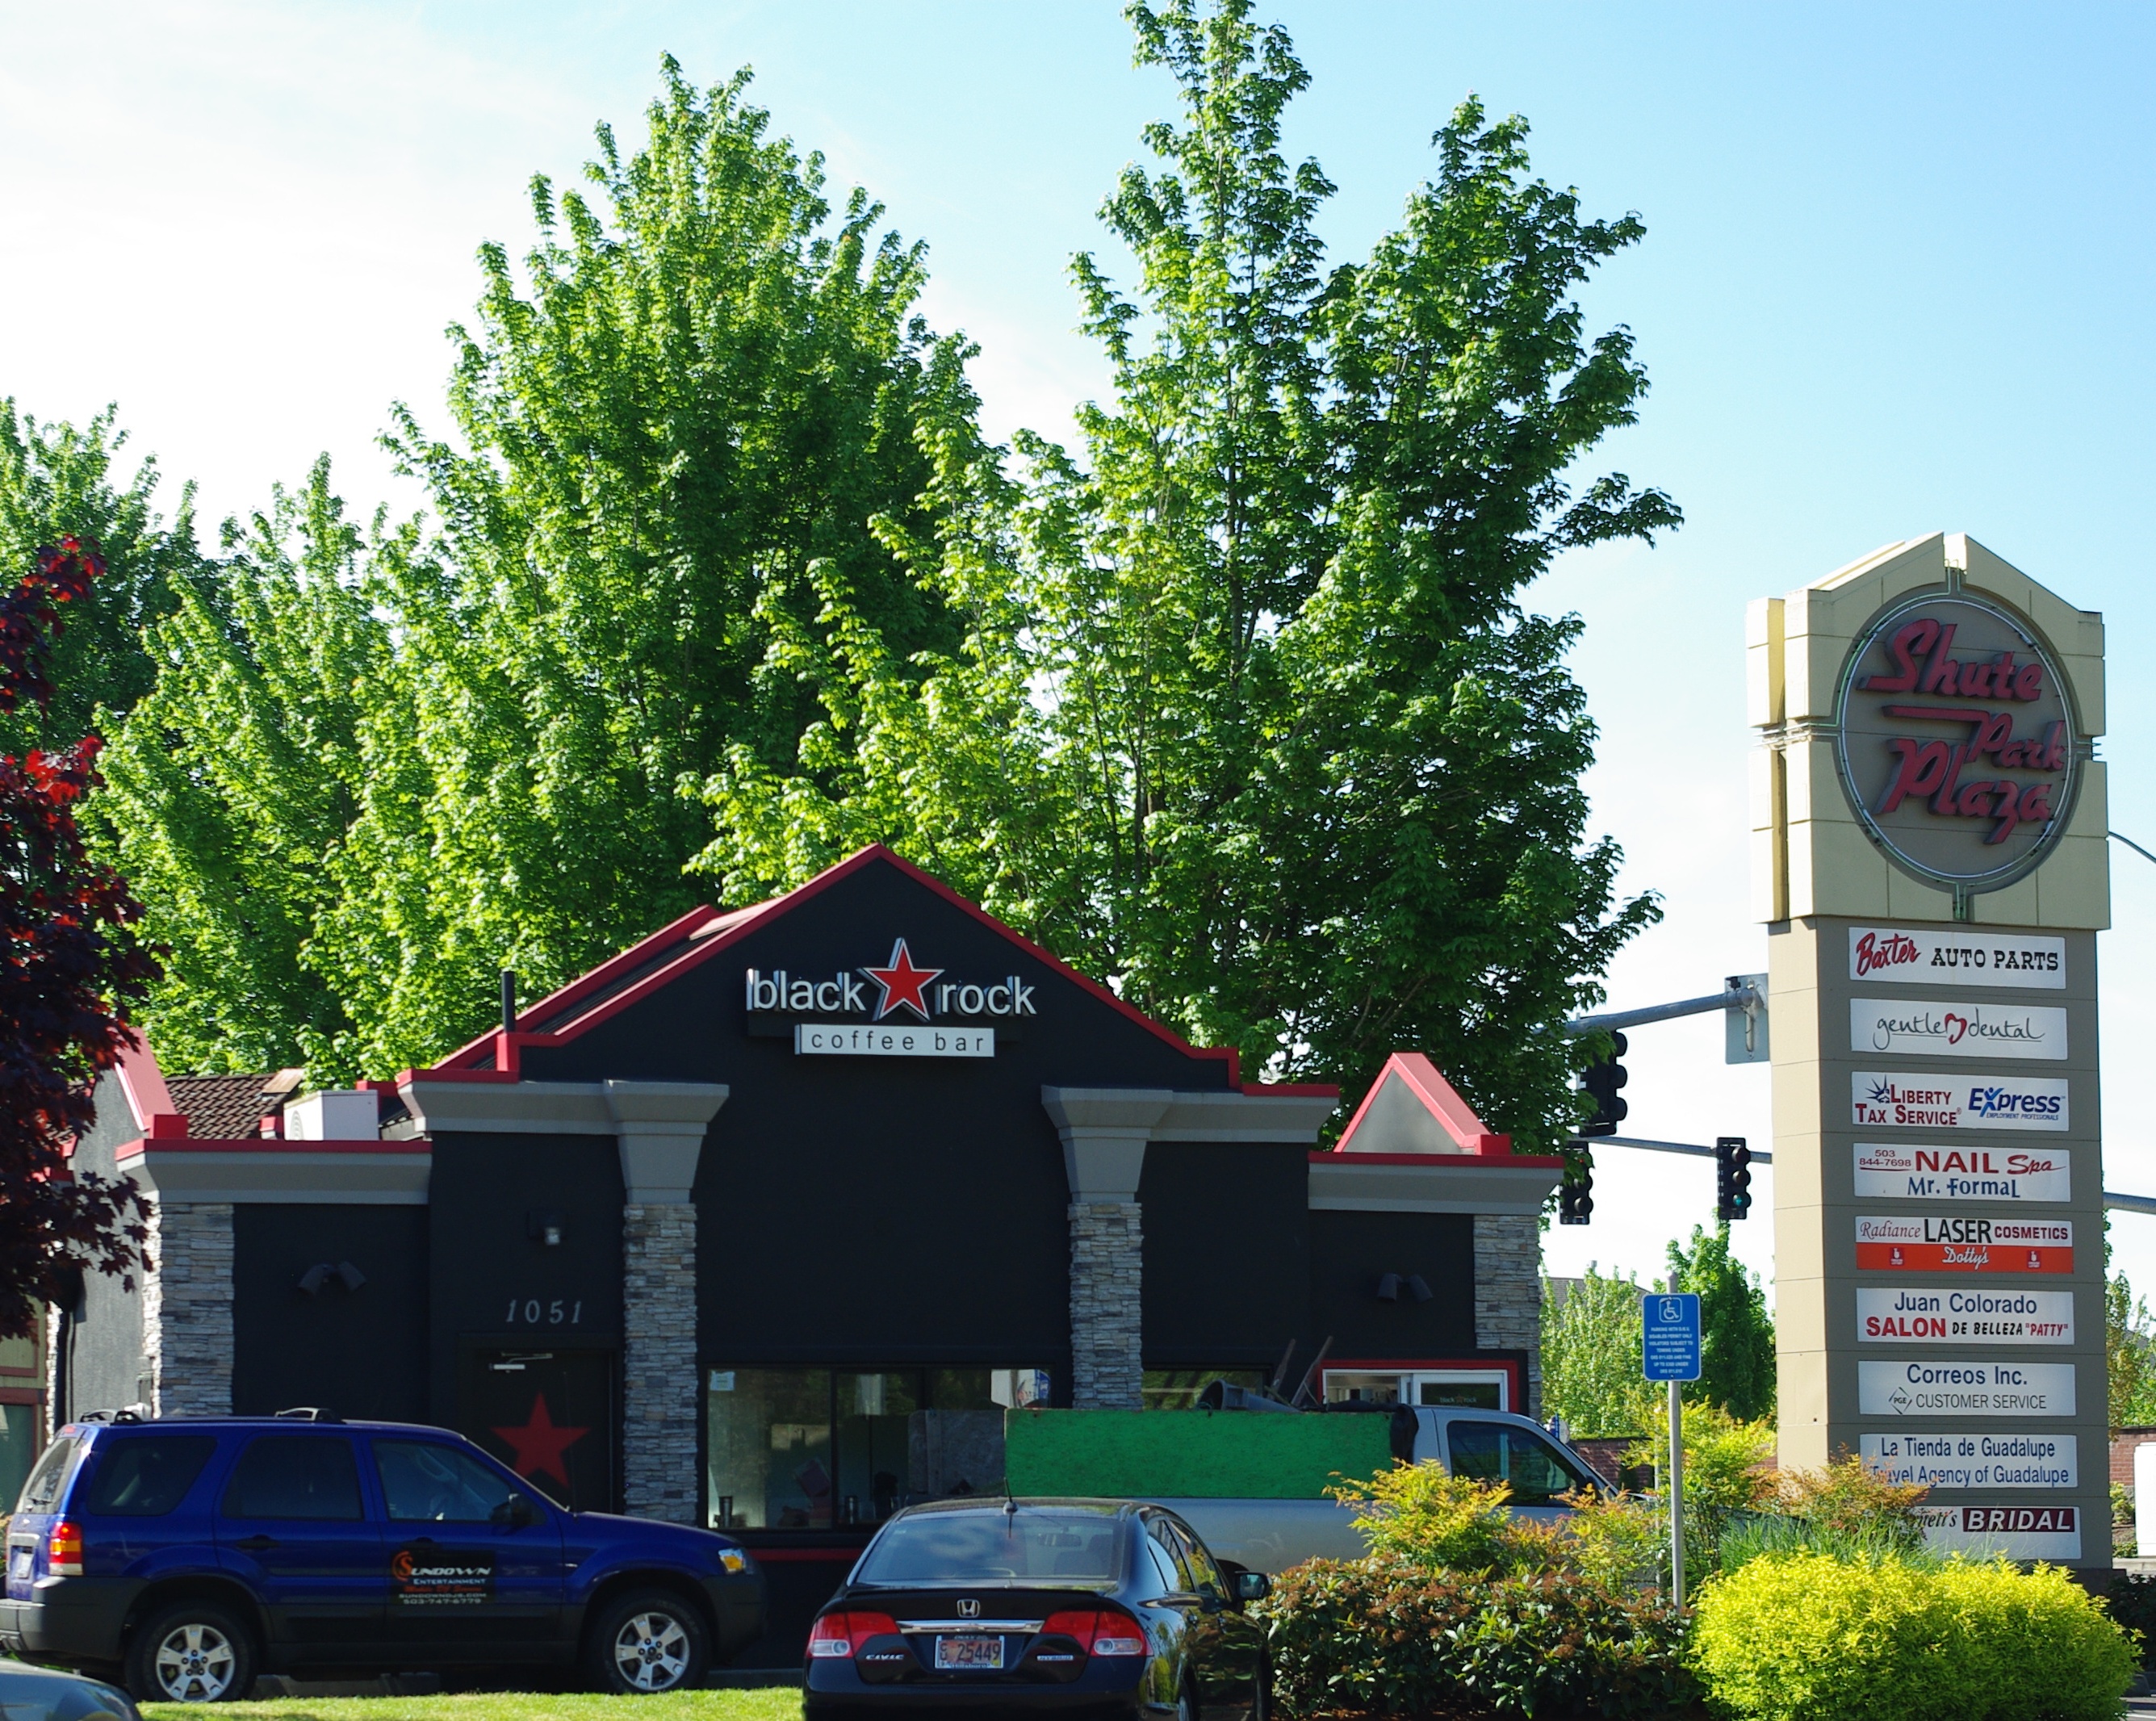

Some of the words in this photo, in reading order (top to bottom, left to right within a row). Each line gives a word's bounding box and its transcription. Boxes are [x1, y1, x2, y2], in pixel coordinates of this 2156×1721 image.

[1859, 618, 2042, 701] Shute
[1882, 705, 2066, 772] Park
[1874, 738, 2052, 844] Plaza
[1857, 932, 1921, 976] Baxter
[1931, 948, 1986, 967] AUTO
[1994, 950, 2058, 971] PARTS
[747, 968, 866, 1011] black
[936, 975, 1037, 1016] rock
[1873, 1012, 1946, 1050] gentle
[1969, 1007, 2045, 1040] dental
[810, 1030, 915, 1050] coffee
[935, 1032, 984, 1051] bar
[1859, 1158, 1911, 1167] 844-7698
[1875, 1149, 1895, 1158] 503
[1915, 1150, 1999, 1175] NAIL
[2007, 1154, 2066, 1175] Spa
[1907, 1176, 1940, 1196] Mr.
[1860, 1221, 1921, 1240] Radiance
[1924, 1219, 1992, 1243] LASER
[1995, 1225, 2068, 1240] COSMETICS
[1941, 1246, 1990, 1271] Dotty's
[506, 1299, 582, 1324] 1051
[1894, 1292, 1940, 1312] Juan
[1949, 1292, 2037, 1314] Colorado
[1866, 1316, 1946, 1338] SALON
[1952, 1321, 1968, 1335] DE
[1974, 1321, 2023, 1336] BELLEZA
[1907, 1363, 1986, 1385] Correos
[1995, 1366, 2028, 1385] Inc.
[1894, 1396, 1907, 1405] PGE
[1915, 1393, 1989, 1409] CUSTOMER
[1992, 1395, 2047, 1409] SERVICE
[1881, 1438, 1898, 1457] La
[1904, 1437, 1951, 1457] Tienda
[1957, 1438, 1974, 1457] de
[1981, 1438, 2055, 1460] Guadalupe
[1918, 1465, 1970, 1488] Agency
[1974, 1465, 1988, 1483] of
[1994, 1465, 2069, 1488] Guadalupe
[1967, 1510, 2071, 1530] BRIDAL
[957, 1643, 1001, 1660] 25449
